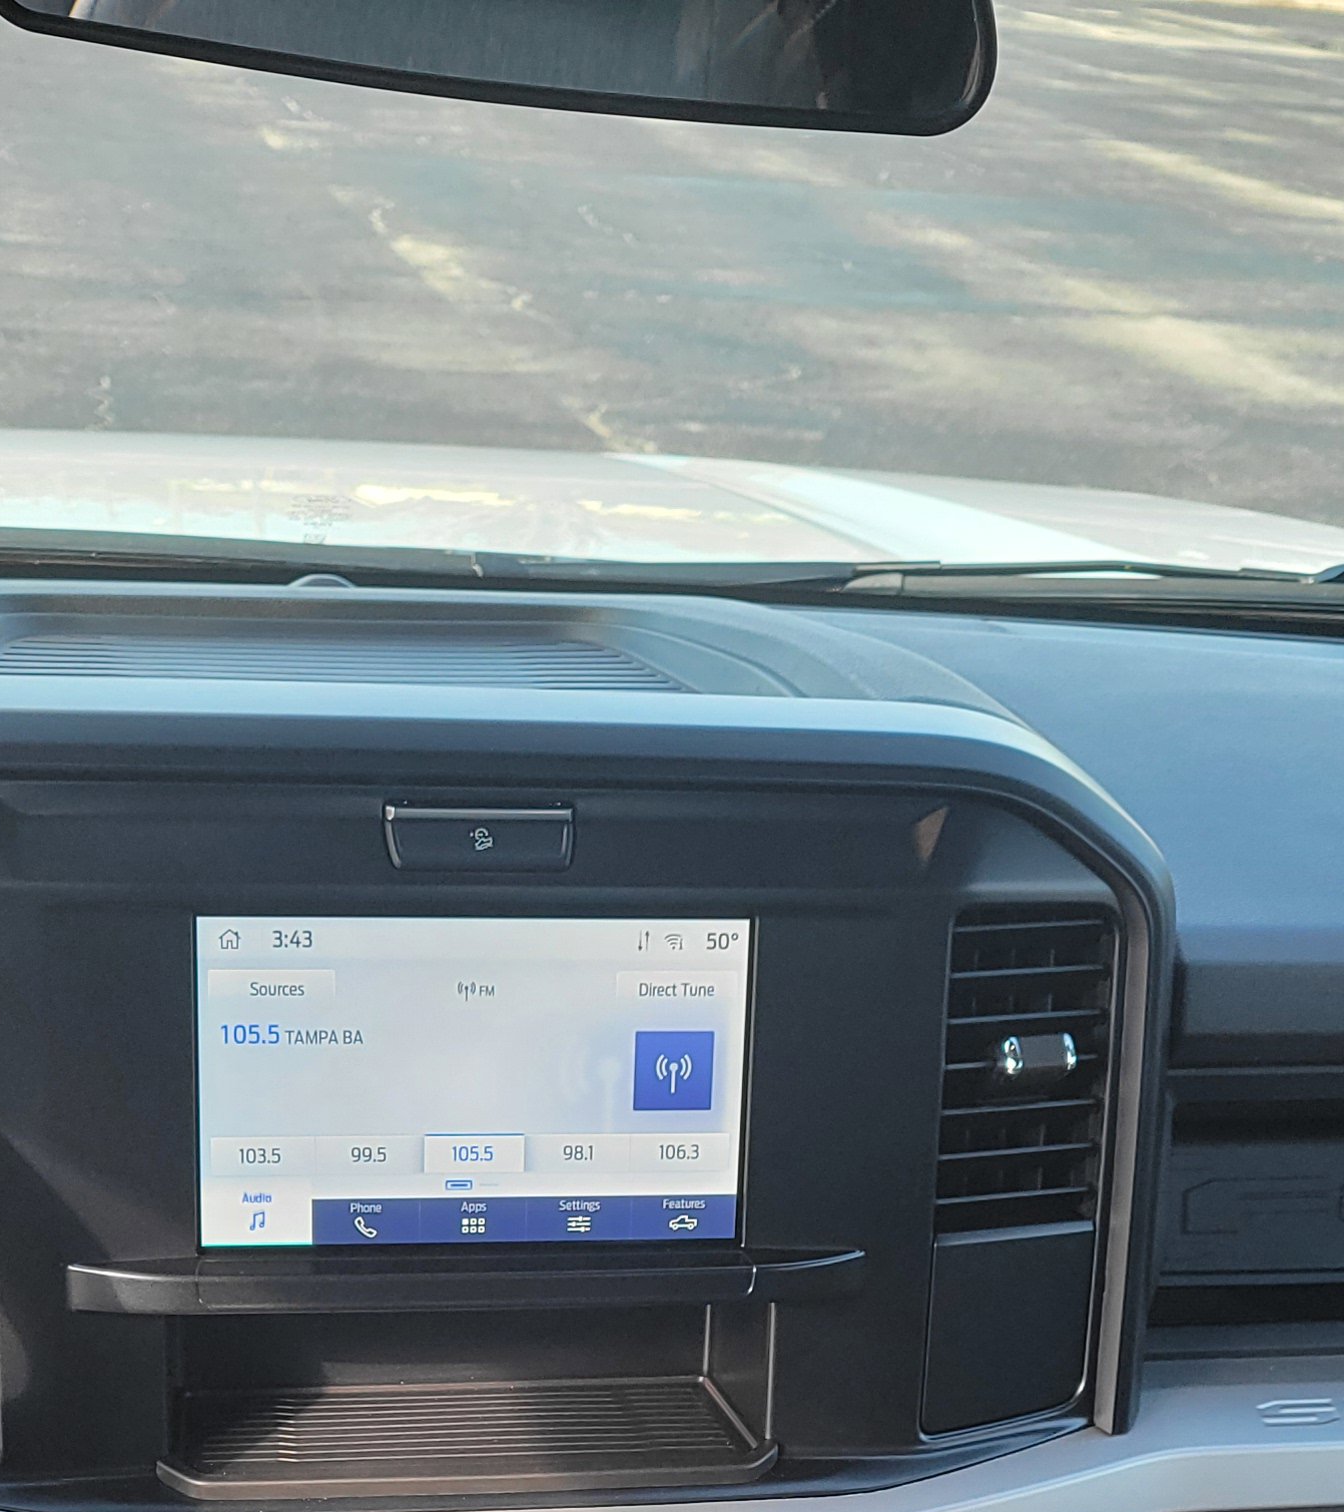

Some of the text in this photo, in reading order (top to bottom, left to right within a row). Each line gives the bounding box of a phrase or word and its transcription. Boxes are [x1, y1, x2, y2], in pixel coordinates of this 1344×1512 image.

[272, 930, 313, 949] 3:43
[706, 931, 739, 951] 50°
[249, 981, 305, 998] Sources
[479, 985, 495, 998] FM
[638, 982, 715, 998] Direct Tune
[220, 1025, 364, 1046] 105.5 TAMPA BA
[238, 1148, 281, 1165] 103.5
[351, 1147, 387, 1164] 99.5
[451, 1146, 494, 1162] 105.5
[562, 1145, 594, 1161] 98.1
[658, 1144, 700, 1160] 106.3
[242, 1193, 272, 1205] Audio
[559, 1199, 601, 1214] Settings
[662, 1197, 706, 1211] Features
[350, 1202, 383, 1215] Phone
[461, 1201, 487, 1215] Apps
